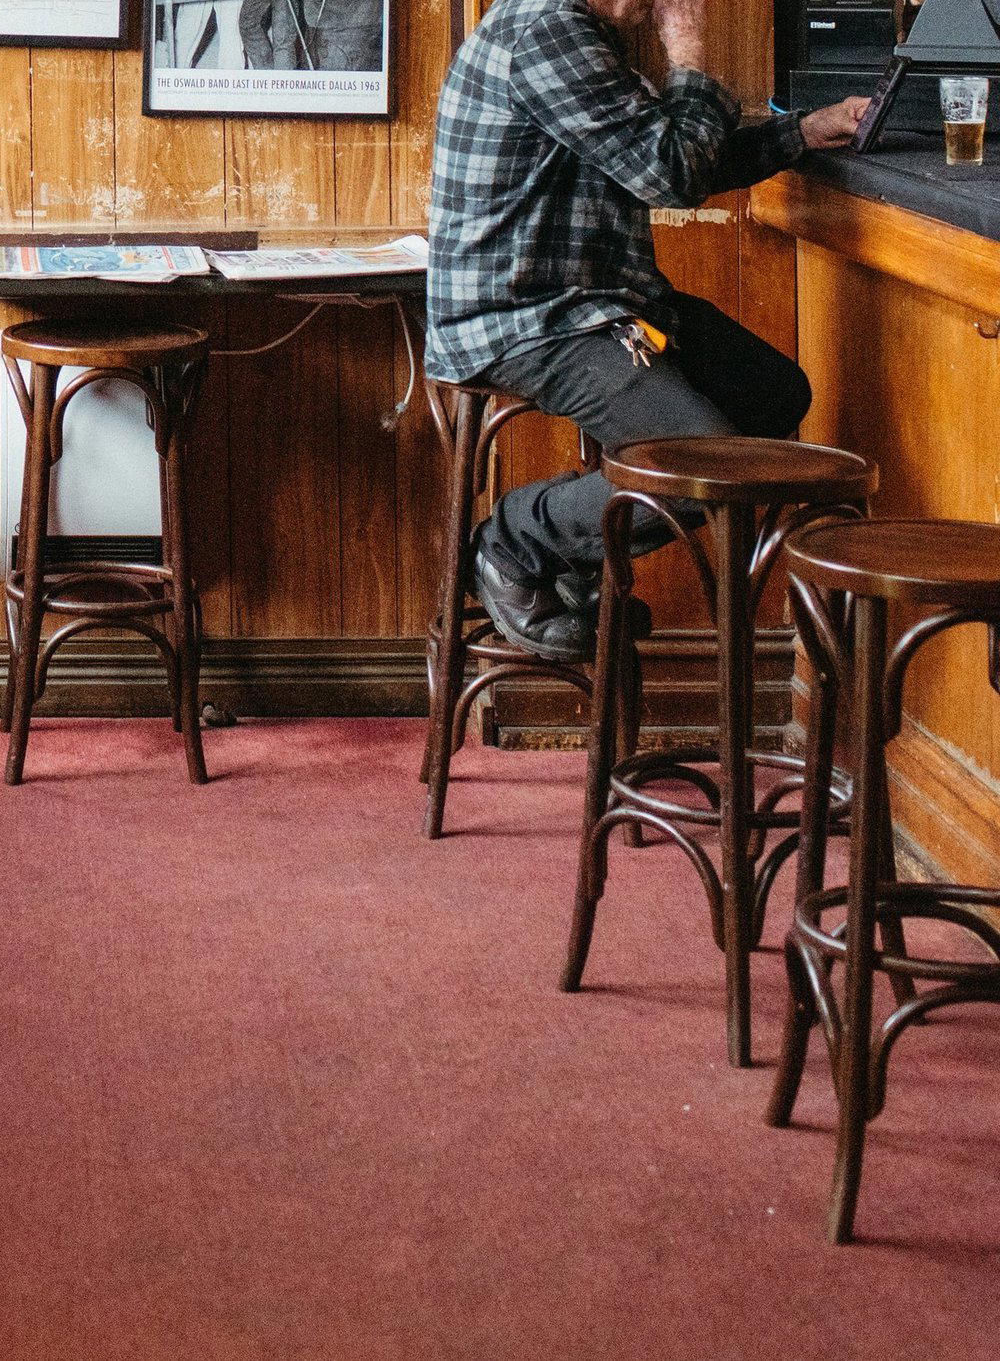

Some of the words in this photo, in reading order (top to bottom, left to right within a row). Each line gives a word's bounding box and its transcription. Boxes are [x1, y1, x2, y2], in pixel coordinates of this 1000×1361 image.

[157, 77, 171, 88] THE
[173, 78, 206, 89] OSWALD
[208, 78, 230, 89] BAND
[232, 79, 252, 89] LAST
[253, 79, 269, 90] LIVE
[271, 80, 326, 91] PERFORMANCE
[329, 80, 358, 91] DALLAS
[360, 81, 381, 92] 1963
